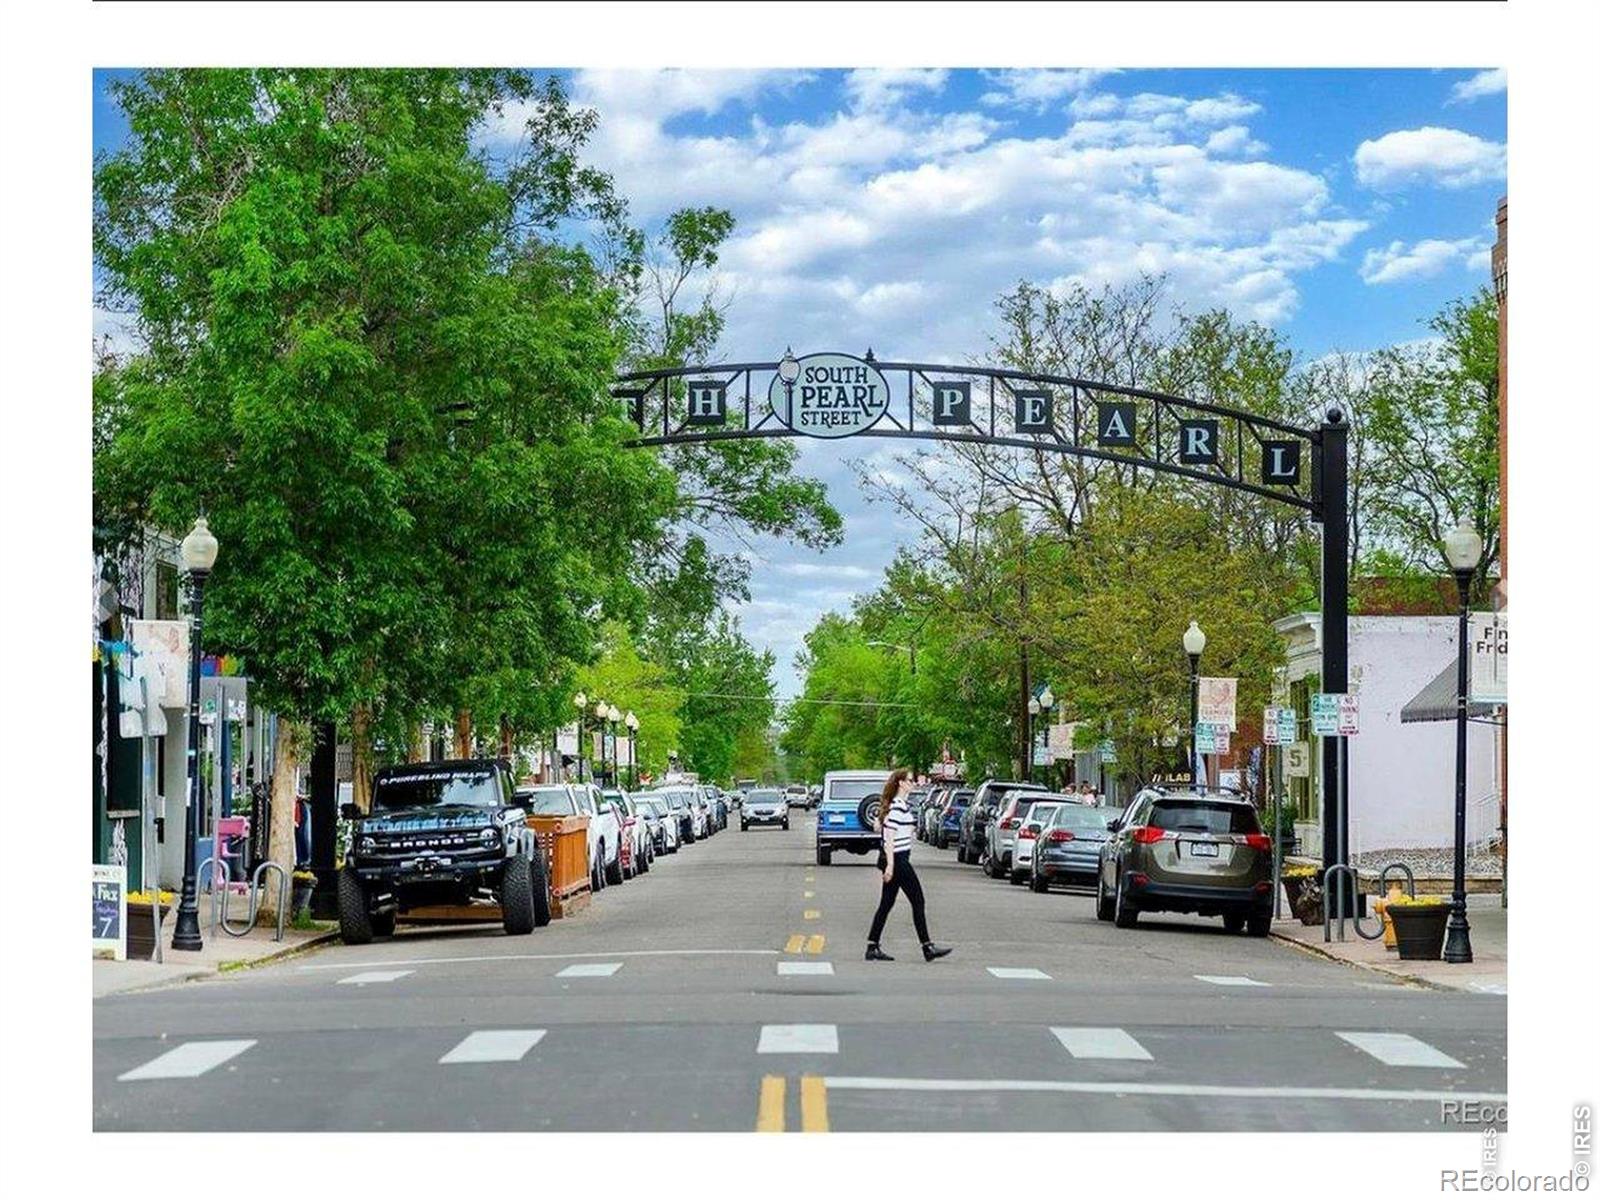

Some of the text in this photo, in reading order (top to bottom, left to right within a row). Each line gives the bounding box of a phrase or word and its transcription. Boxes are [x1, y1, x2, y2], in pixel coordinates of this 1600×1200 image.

[805, 366, 867, 384] SOUTH
[801, 385, 883, 417] PEARL
[801, 411, 864, 429] STREET
[940, 389, 1296, 476] PEARL
[1484, 627, 1508, 639] Fn
[1477, 641, 1508, 653] Frd
[390, 838, 464, 848] BRONCO
